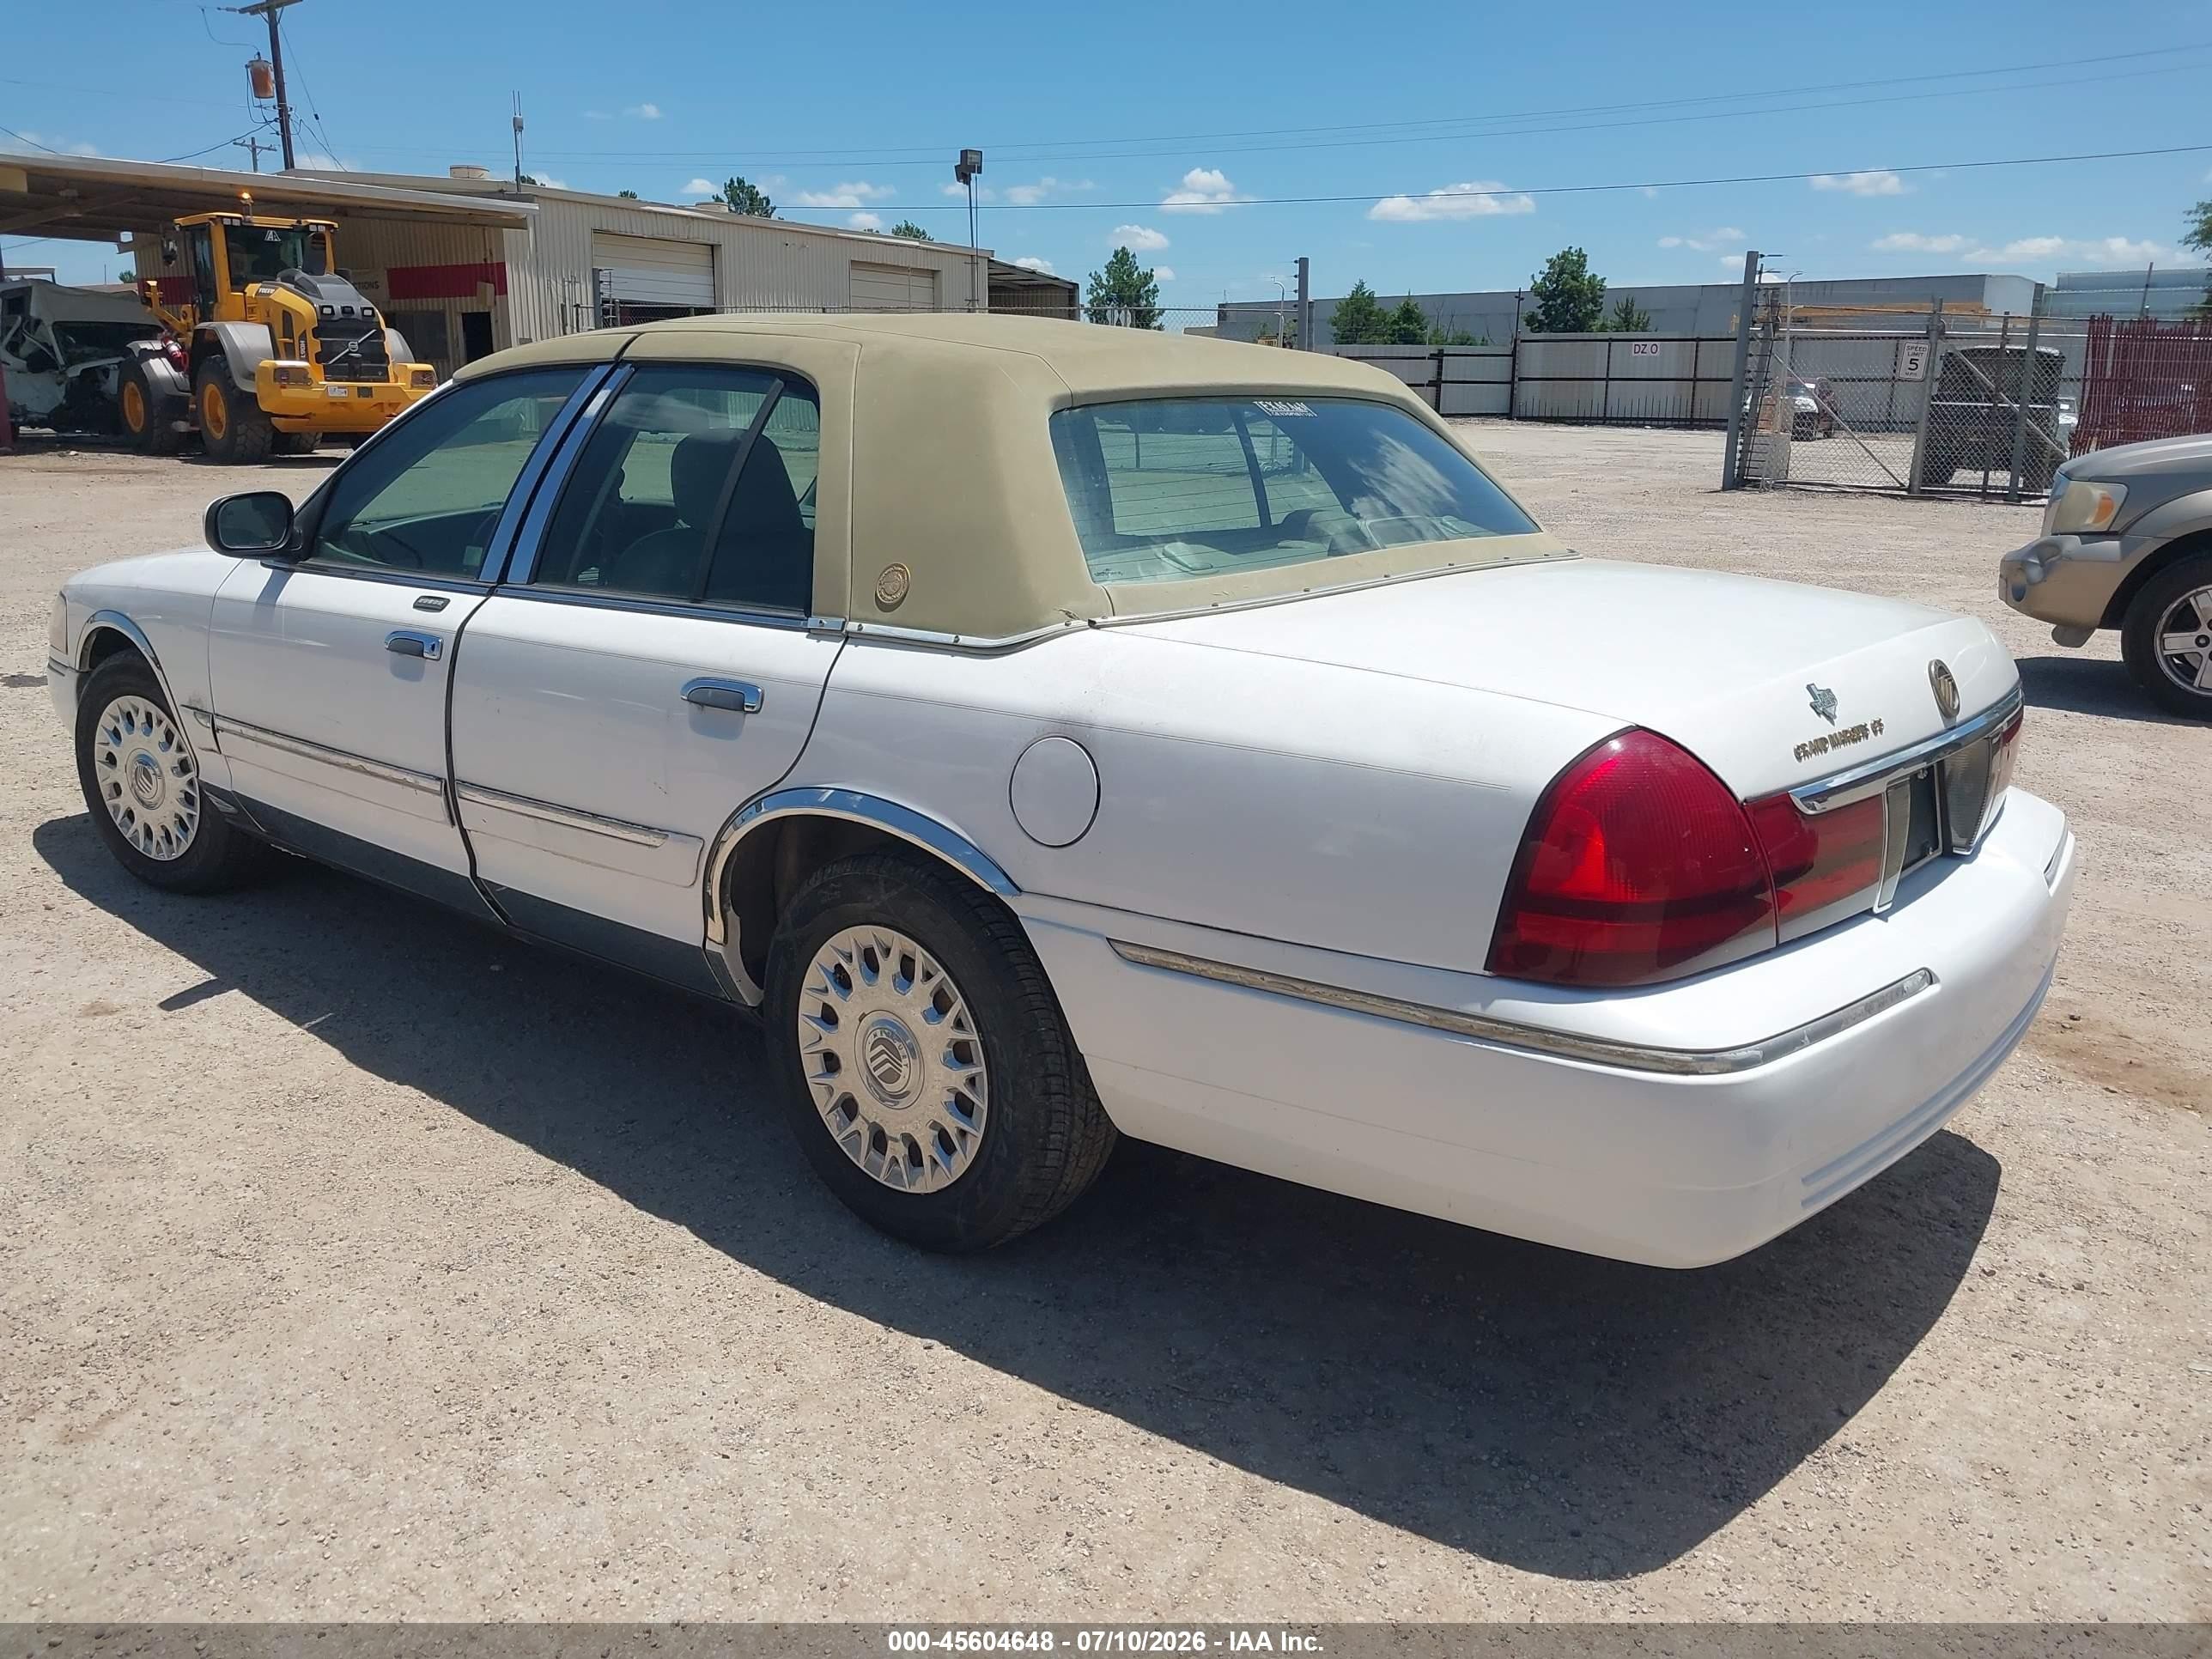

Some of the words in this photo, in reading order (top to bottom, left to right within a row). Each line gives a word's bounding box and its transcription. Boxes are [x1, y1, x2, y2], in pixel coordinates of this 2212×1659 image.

[1633, 343, 1647, 354] DZ
[1907, 358, 1919, 371] 5
[1794, 737, 1829, 763] GRAND
